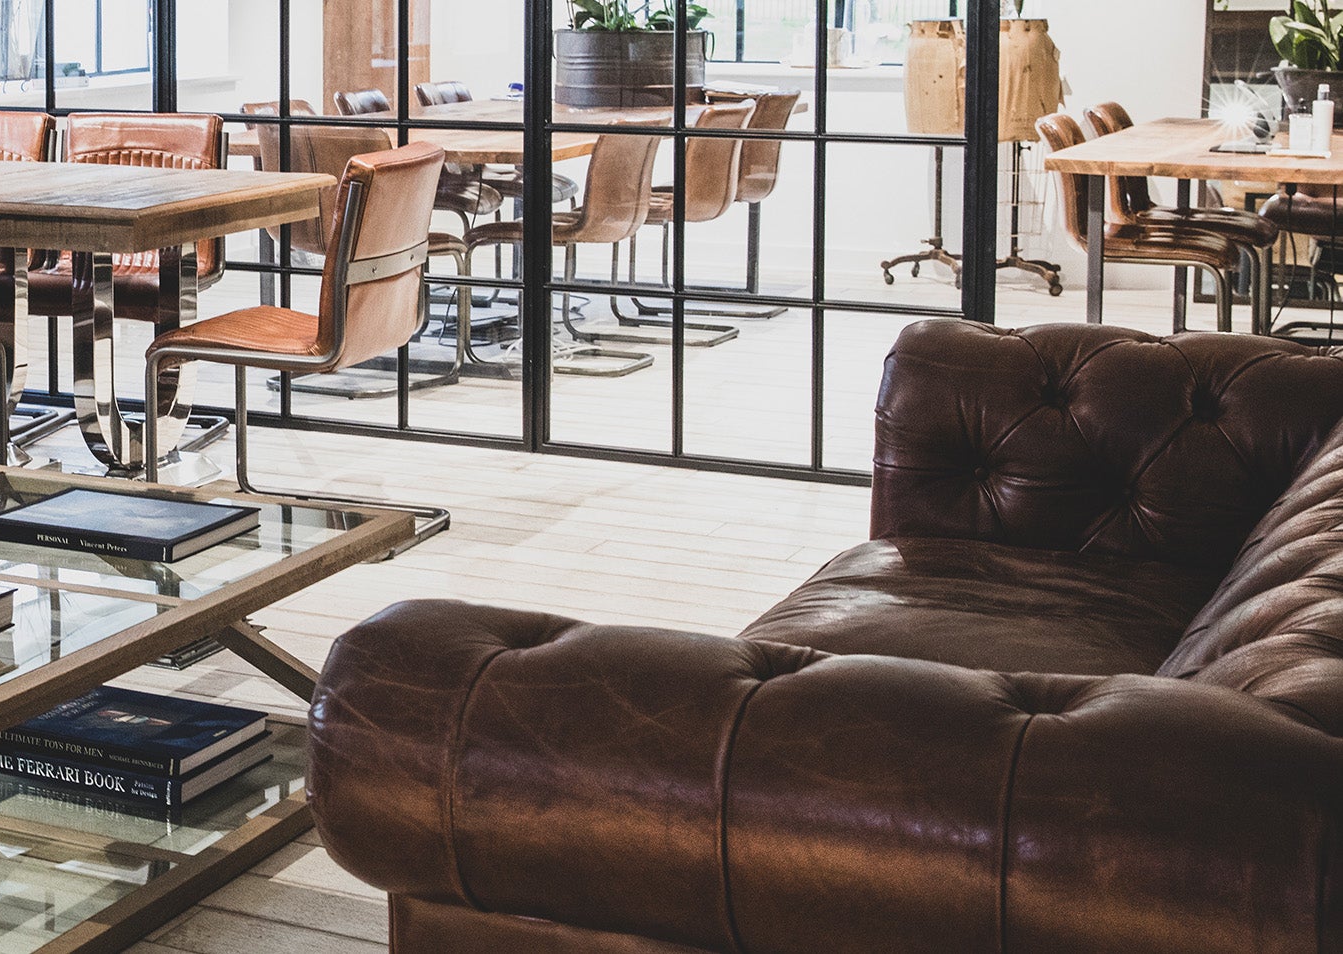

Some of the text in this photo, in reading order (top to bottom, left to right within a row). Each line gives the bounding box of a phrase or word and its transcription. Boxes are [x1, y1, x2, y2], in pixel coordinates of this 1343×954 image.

[37, 534, 128, 552] PERSONAL Vincent Peters
[44, 739, 65, 751] TOYS
[66, 741, 83, 754] FOR
[83, 744, 104, 758] MEN
[16, 756, 80, 784] FERRARI
[84, 770, 126, 793] BOOK
